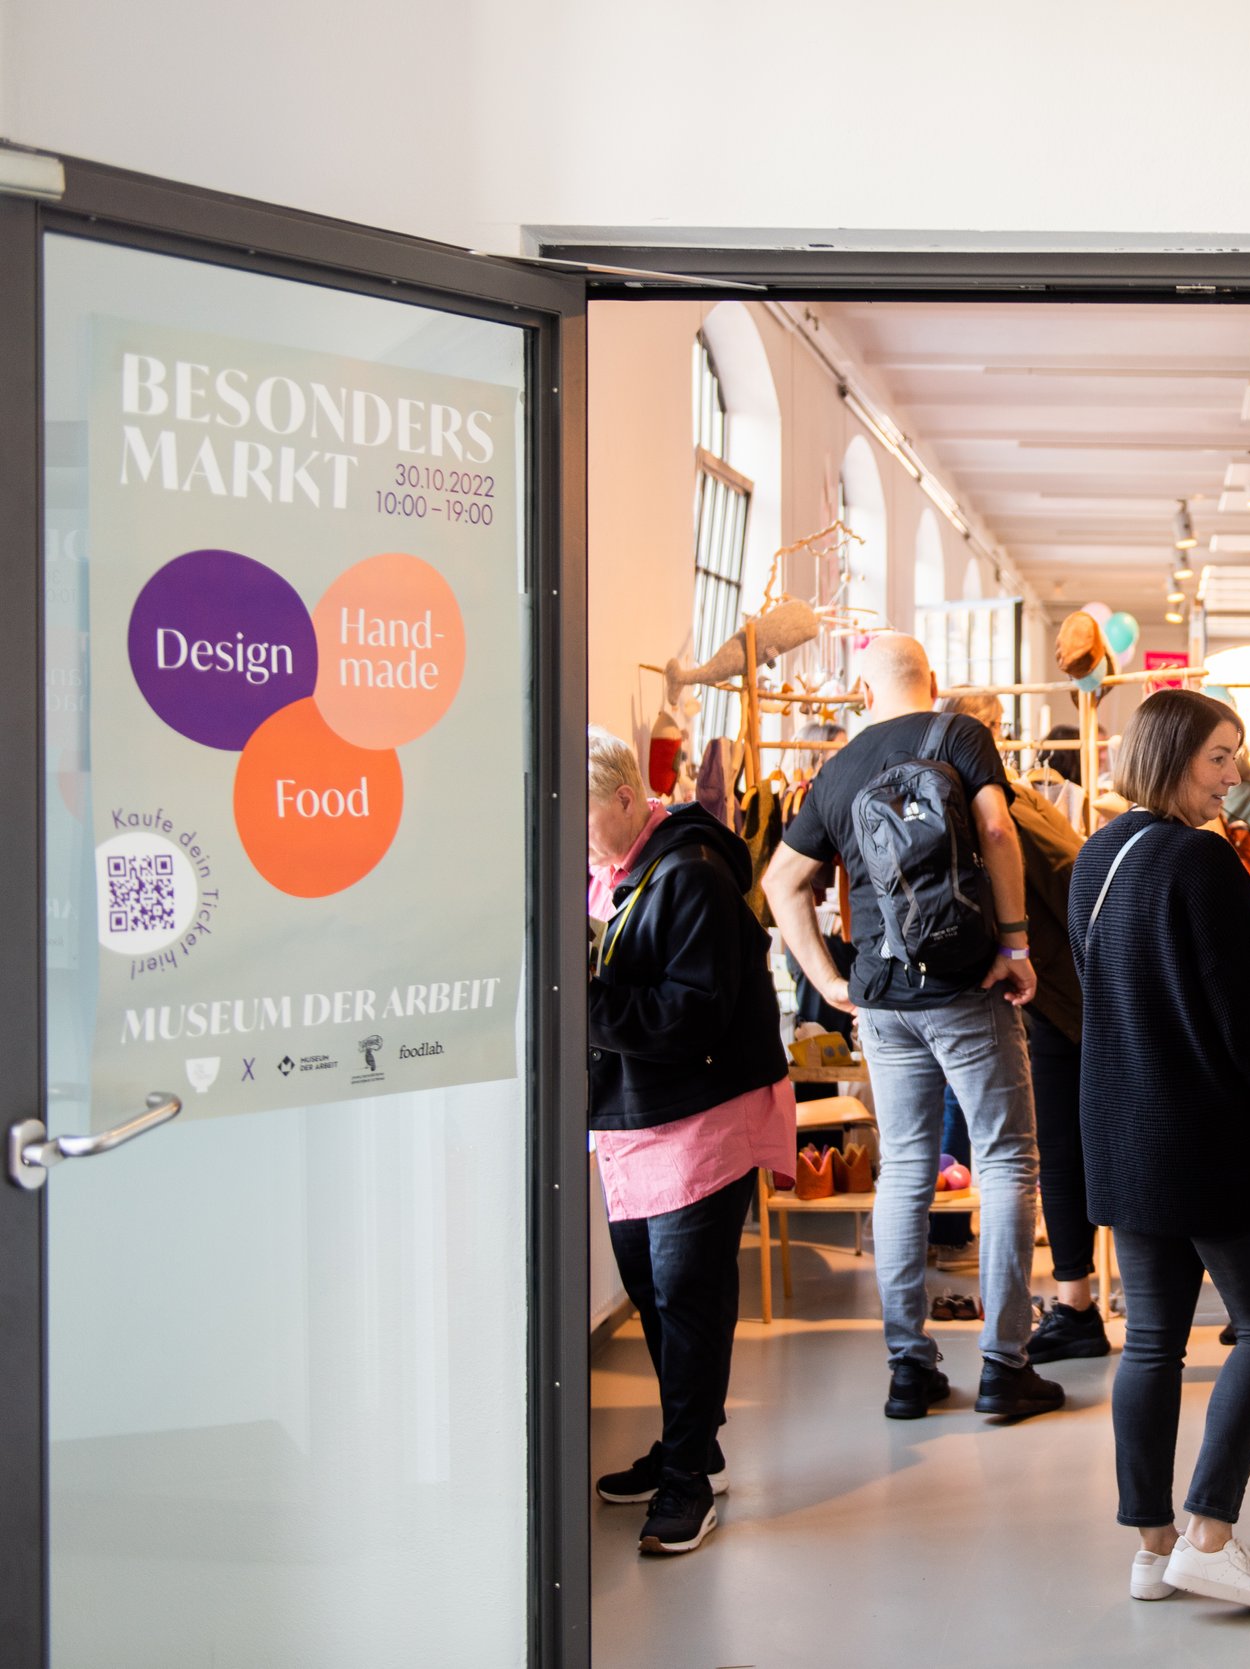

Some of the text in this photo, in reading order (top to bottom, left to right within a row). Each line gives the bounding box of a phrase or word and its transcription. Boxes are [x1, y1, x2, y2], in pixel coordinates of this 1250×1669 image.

[122, 352, 495, 464] BESONDERS
[120, 425, 359, 510] MARKT
[394, 463, 496, 498] 30.10.2022
[375, 490, 428, 518] 10:00
[444, 499, 494, 526] 19:00
[340, 607, 446, 649] Hand-
[156, 627, 294, 685] Design
[340, 651, 440, 691] made
[276, 777, 370, 818] Food
[112, 808, 220, 980] Kaufe dein Ticket hier!
[121, 977, 501, 1043] MUSEUM DER ARBEIT
[300, 1061, 339, 1072] DER ARBEIT
[301, 1054, 330, 1064] MUSEUM
[399, 1041, 445, 1060] foodlab.
